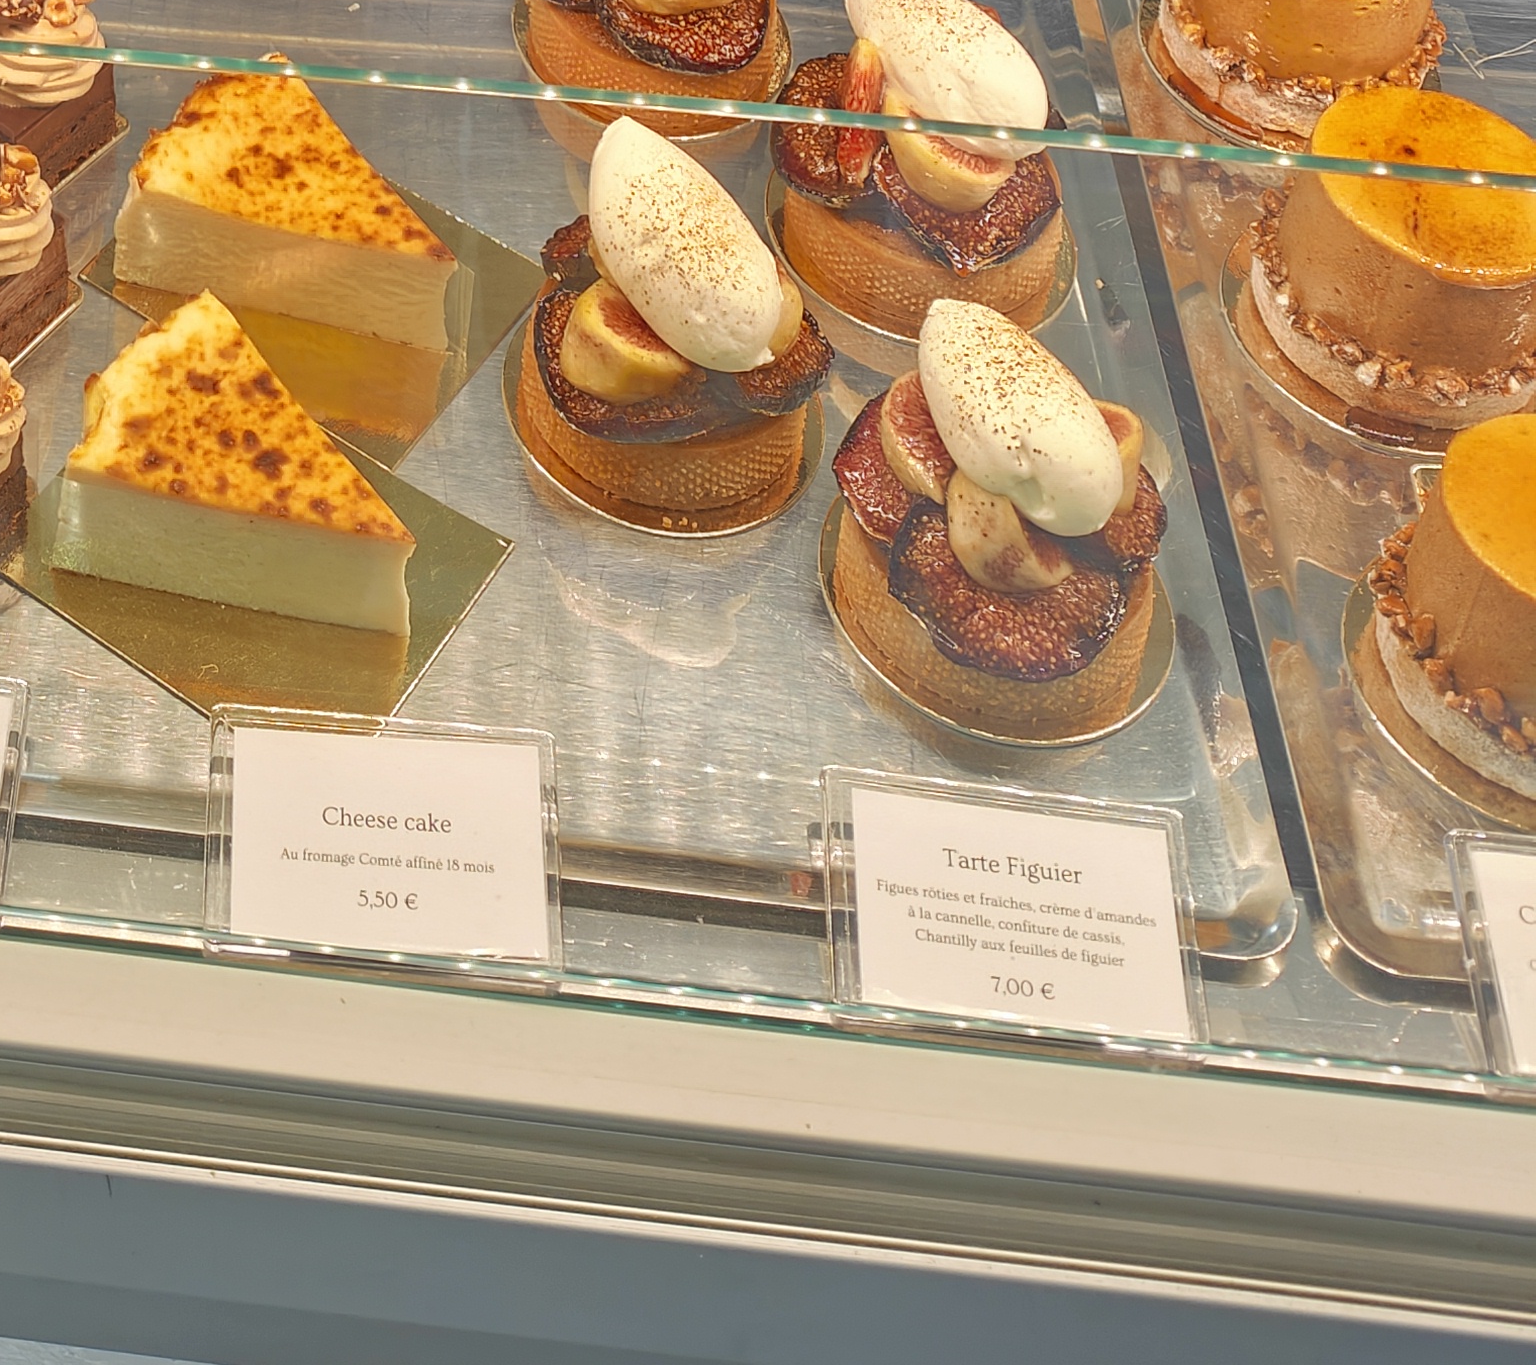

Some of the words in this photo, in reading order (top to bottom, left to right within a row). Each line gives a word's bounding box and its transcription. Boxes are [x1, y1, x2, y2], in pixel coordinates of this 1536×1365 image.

[322, 807, 397, 830] Cheese
[405, 813, 452, 833] cake
[281, 848, 298, 860] Au
[302, 850, 355, 866] fromage
[358, 853, 402, 868] Comté
[405, 856, 443, 870] affiné
[446, 859, 459, 871] 18
[463, 861, 495, 873] mois
[942, 848, 1000, 874] Tarte
[1006, 857, 1082, 884] Figuier
[357, 890, 398, 909] 5,50
[405, 893, 418, 910] €
[876, 879, 919, 897] Figues
[921, 886, 960, 903] rôties
[963, 891, 975, 905] et
[1039, 901, 1080, 919] crème
[1084, 906, 1157, 928] d'amandes
[908, 906, 916, 918] à
[919, 907, 931, 920] la
[935, 911, 994, 930] cannelle,
[998, 919, 1059, 937] confiture
[1063, 926, 1078, 939] de
[915, 928, 977, 950] Chantilly
[981, 939, 1005, 953] aux
[1009, 940, 1057, 959] feuilles
[1061, 948, 1077, 960] de
[1081, 948, 1125, 968] figuier
[990, 975, 1034, 998] 7,00
[1041, 983, 1056, 1000] €
